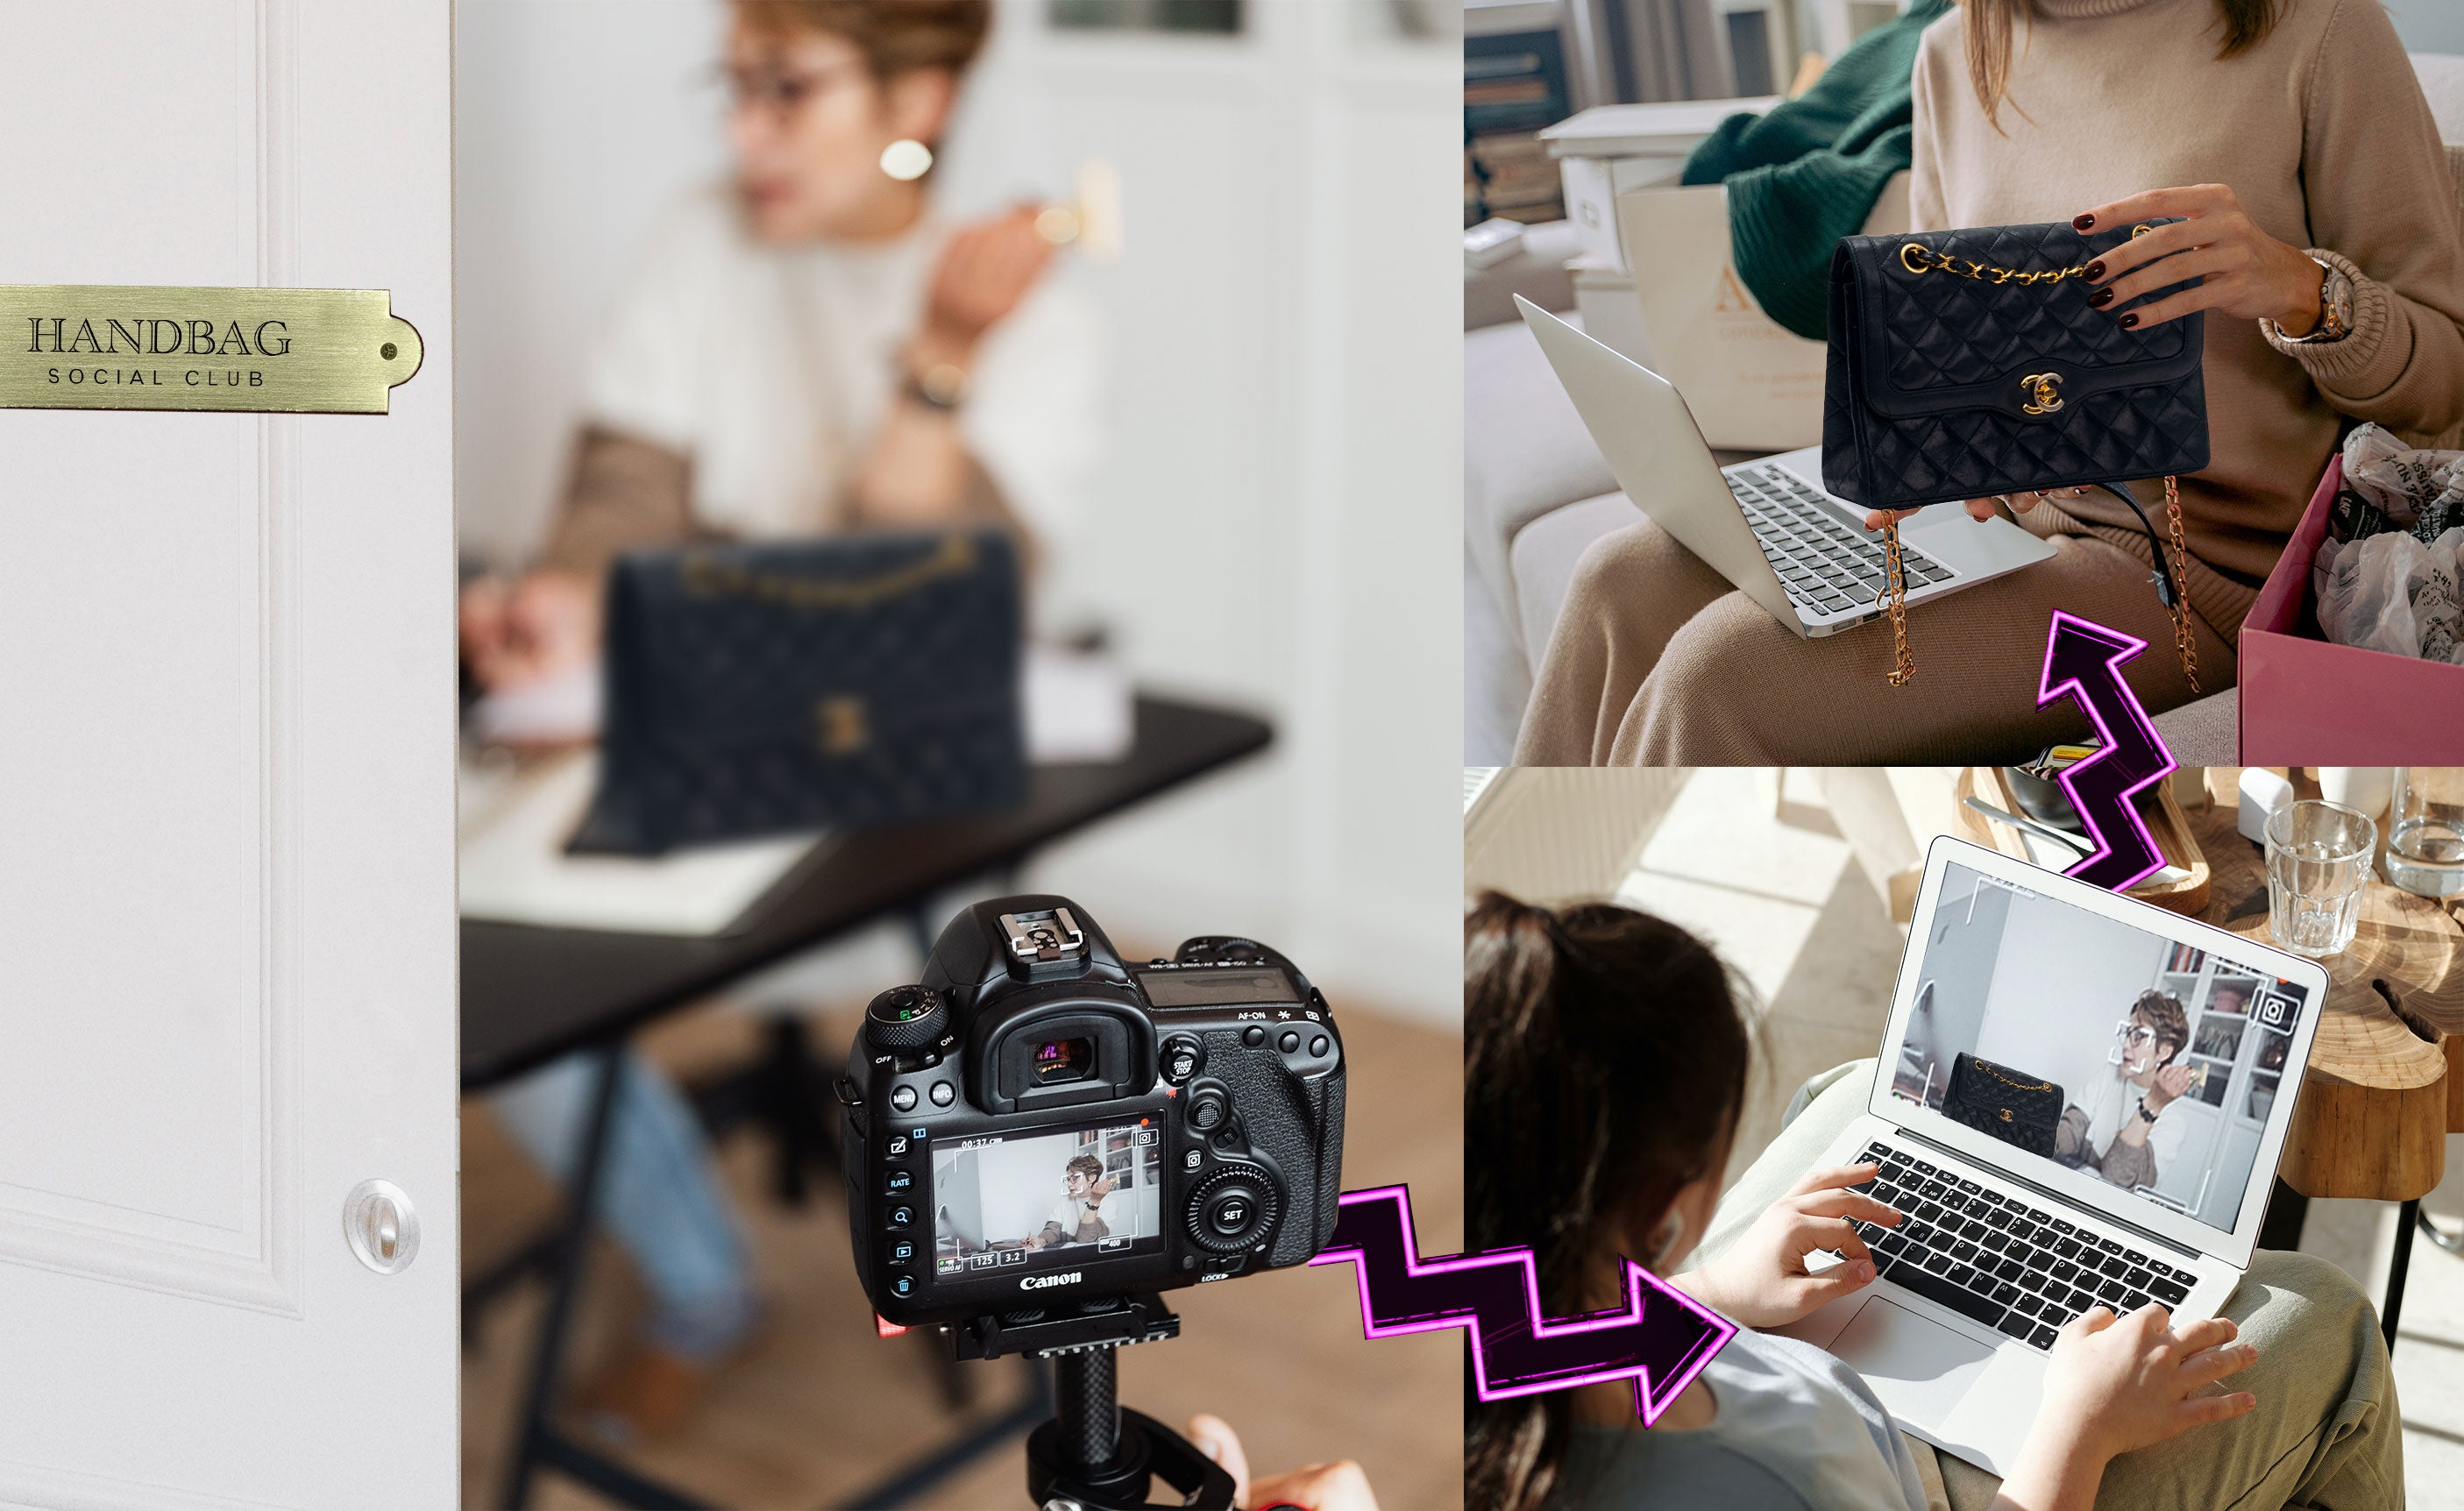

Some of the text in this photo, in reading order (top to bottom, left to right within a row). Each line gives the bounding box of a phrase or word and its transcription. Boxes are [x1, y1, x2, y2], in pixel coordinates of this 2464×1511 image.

[27, 317, 292, 357] HANDBAG
[47, 368, 264, 387] SOCIAL CLUB
[1238, 1011, 1267, 1020] AF-ON
[941, 1035, 954, 1046] ON
[875, 1055, 892, 1064] OFF
[1175, 1067, 1191, 1075] STOP
[893, 1094, 916, 1104] MENU
[961, 1139, 987, 1150] 00:37
[891, 1177, 911, 1188] RATE
[1223, 1210, 1243, 1221] SET
[1108, 1238, 1121, 1248] 400
[976, 1252, 1020, 1266] 125 3.2
[1020, 1272, 1082, 1291] Canon
[1201, 1273, 1223, 1282] LOCK
